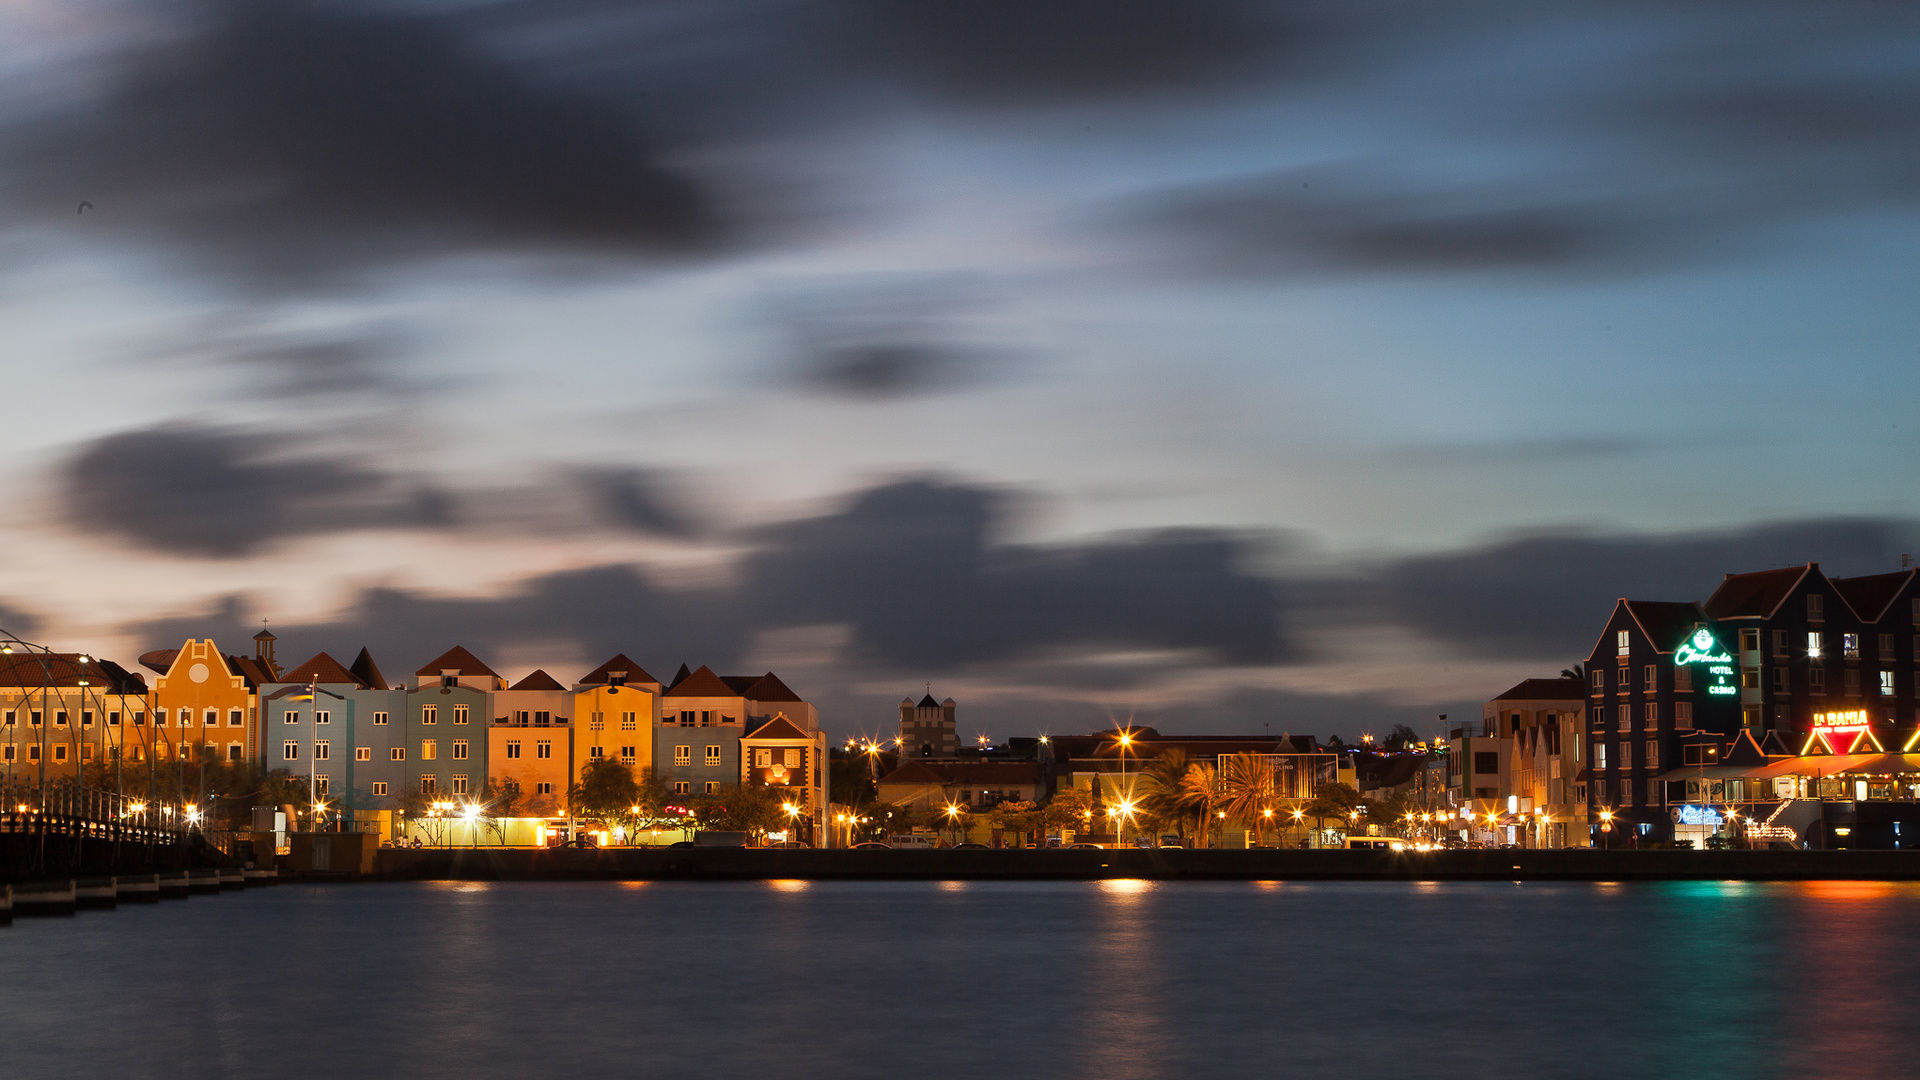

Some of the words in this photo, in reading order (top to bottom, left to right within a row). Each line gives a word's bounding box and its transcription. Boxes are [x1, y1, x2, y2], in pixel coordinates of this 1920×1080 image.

[1710, 666, 1734, 674] HOTEL
[1718, 676, 1725, 684] &
[1709, 686, 1736, 695] CASINO
[1813, 713, 1825, 726] LA
[1827, 710, 1868, 726] BAHIA
